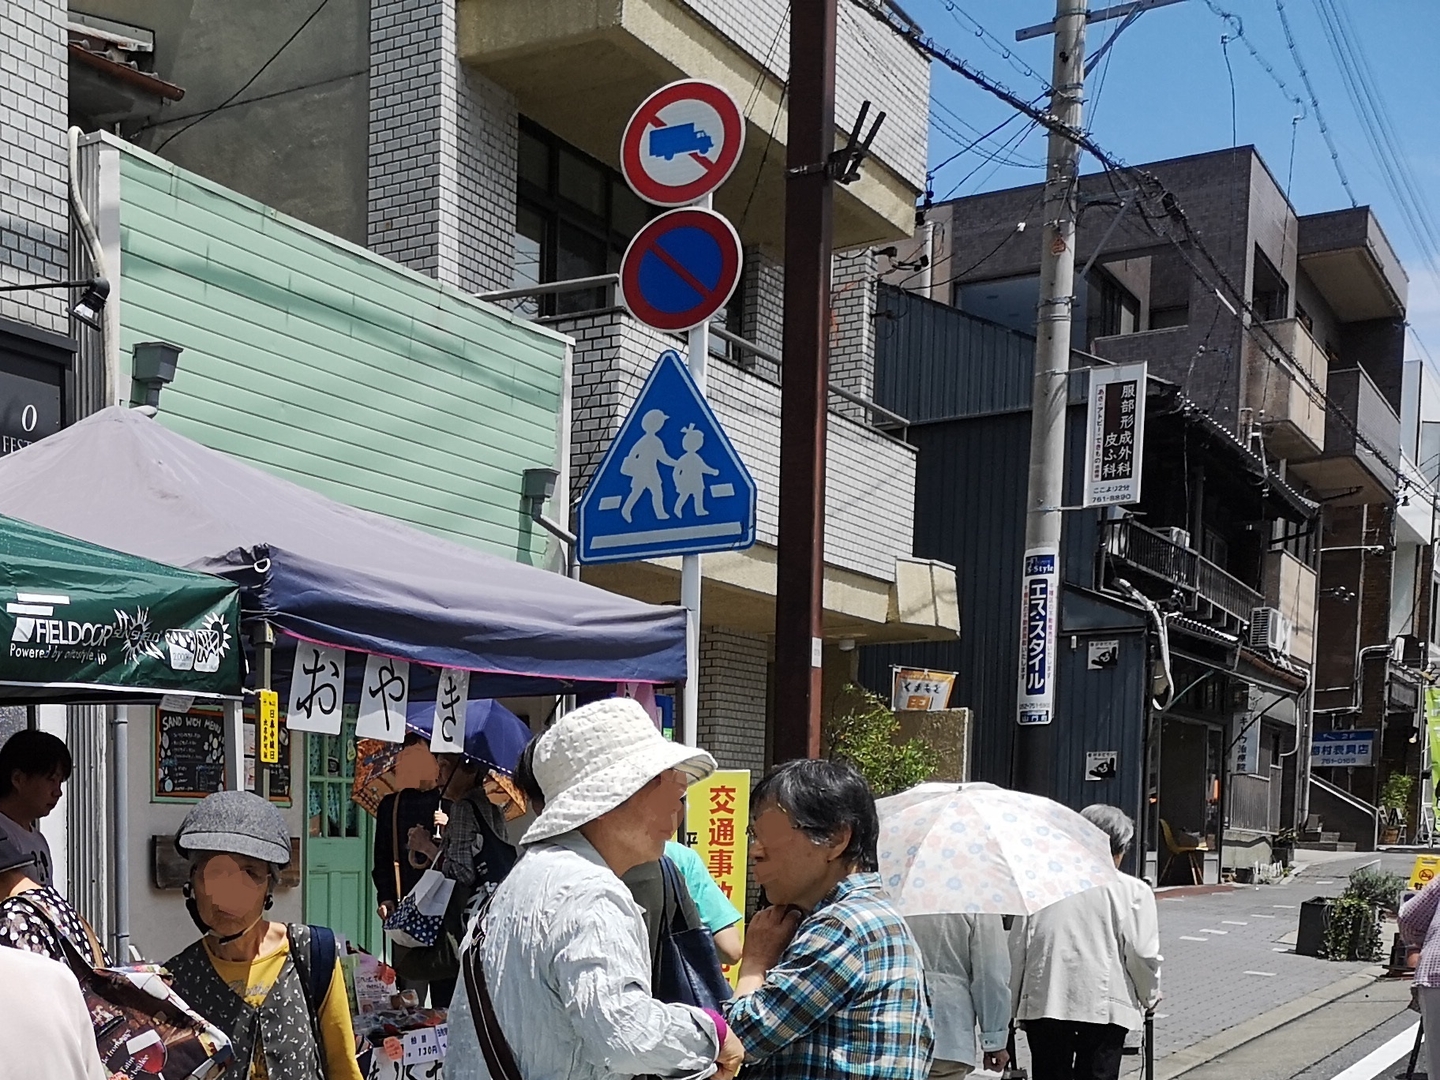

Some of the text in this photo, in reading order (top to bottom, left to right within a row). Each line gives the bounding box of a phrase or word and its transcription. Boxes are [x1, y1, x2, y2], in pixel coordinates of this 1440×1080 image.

[1116, 384, 1136, 477] 服部形成外科
[1102, 432, 1118, 478] 皮ふ科
[9, 642, 51, 659] Powered
[51, 645, 63, 662] by
[1027, 583, 1047, 690] エス・スタイル
[296, 647, 462, 744] おやき
[204, 719, 222, 734] MENU
[418, 1045, 438, 1057] 130円
